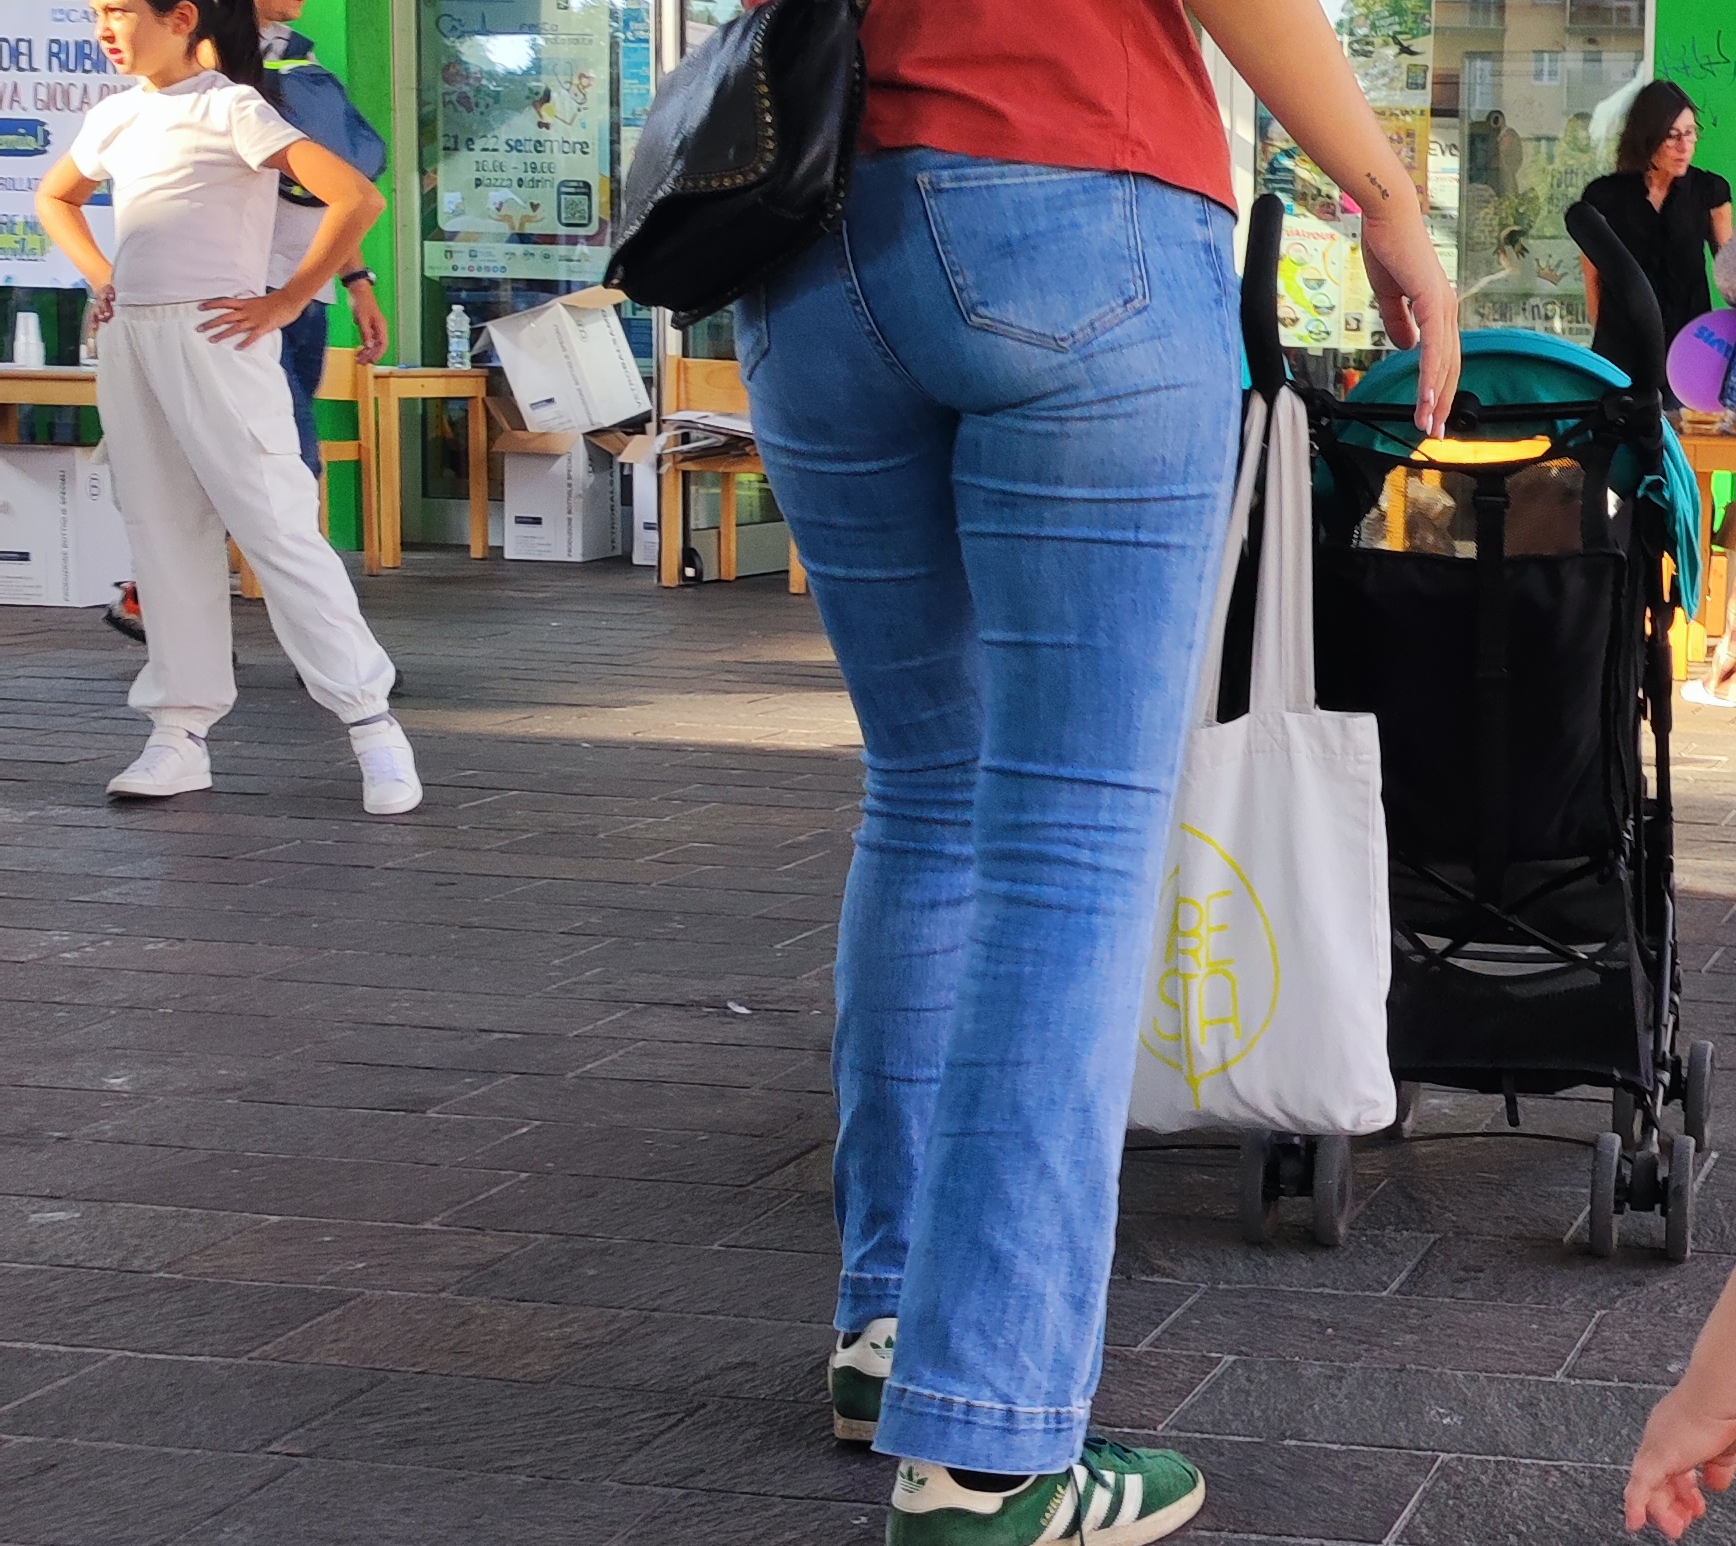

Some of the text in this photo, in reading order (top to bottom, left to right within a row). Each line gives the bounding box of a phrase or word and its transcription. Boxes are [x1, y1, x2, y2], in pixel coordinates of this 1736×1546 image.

[0, 37, 40, 72] DEL
[34, 81, 92, 112] GIOCA
[442, 133, 590, 155] 21 e 22 settembre
[474, 176, 513, 189] piazza
[1040, 1483, 1067, 1527] GAZELLE
